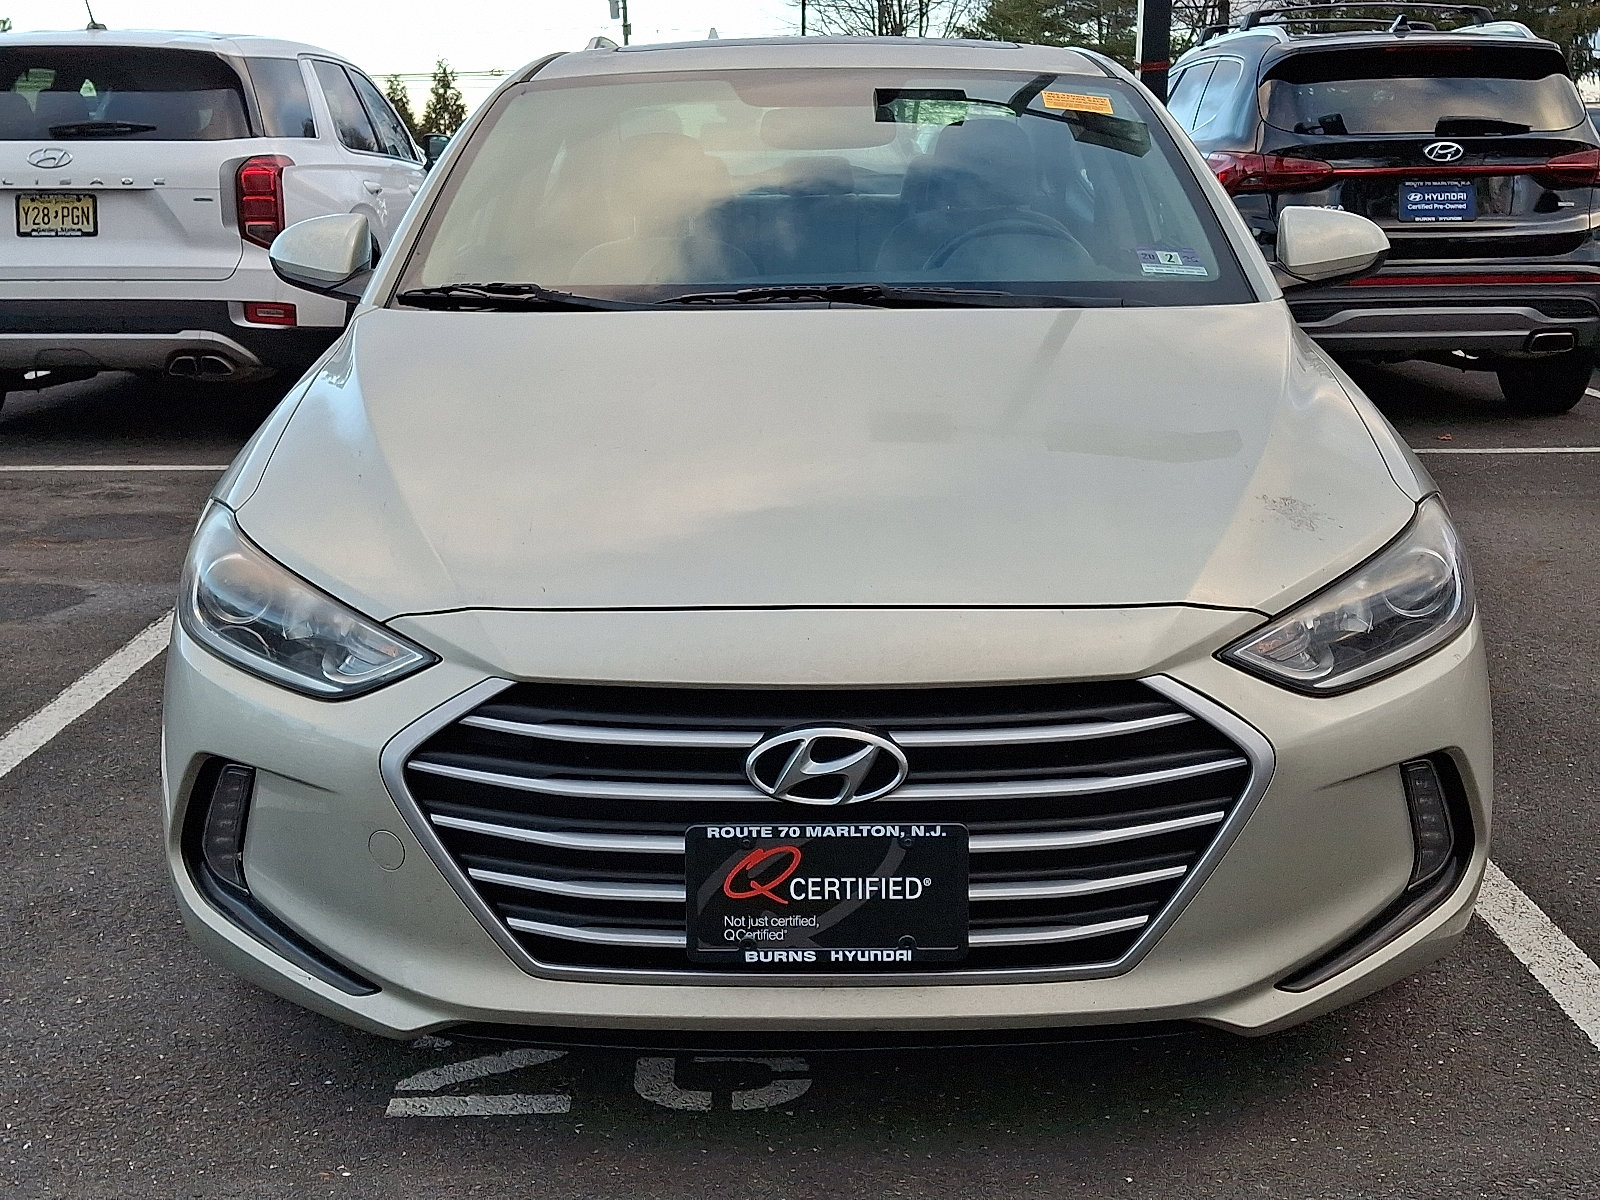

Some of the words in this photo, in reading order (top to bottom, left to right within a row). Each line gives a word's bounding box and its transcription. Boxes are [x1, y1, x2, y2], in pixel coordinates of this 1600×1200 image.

[1425, 192, 1467, 201] HYUNDAI
[1164, 253, 1176, 264] 2
[707, 826, 773, 839] ROUTE
[778, 826, 801, 838] 70
[806, 826, 906, 839] MARLTON,
[911, 825, 948, 838] N.J.
[724, 915, 746, 927] Not
[747, 915, 769, 930] just
[770, 914, 820, 929] certified,
[745, 950, 817, 962] BURNS
[830, 950, 912, 962] HYUNDAI
